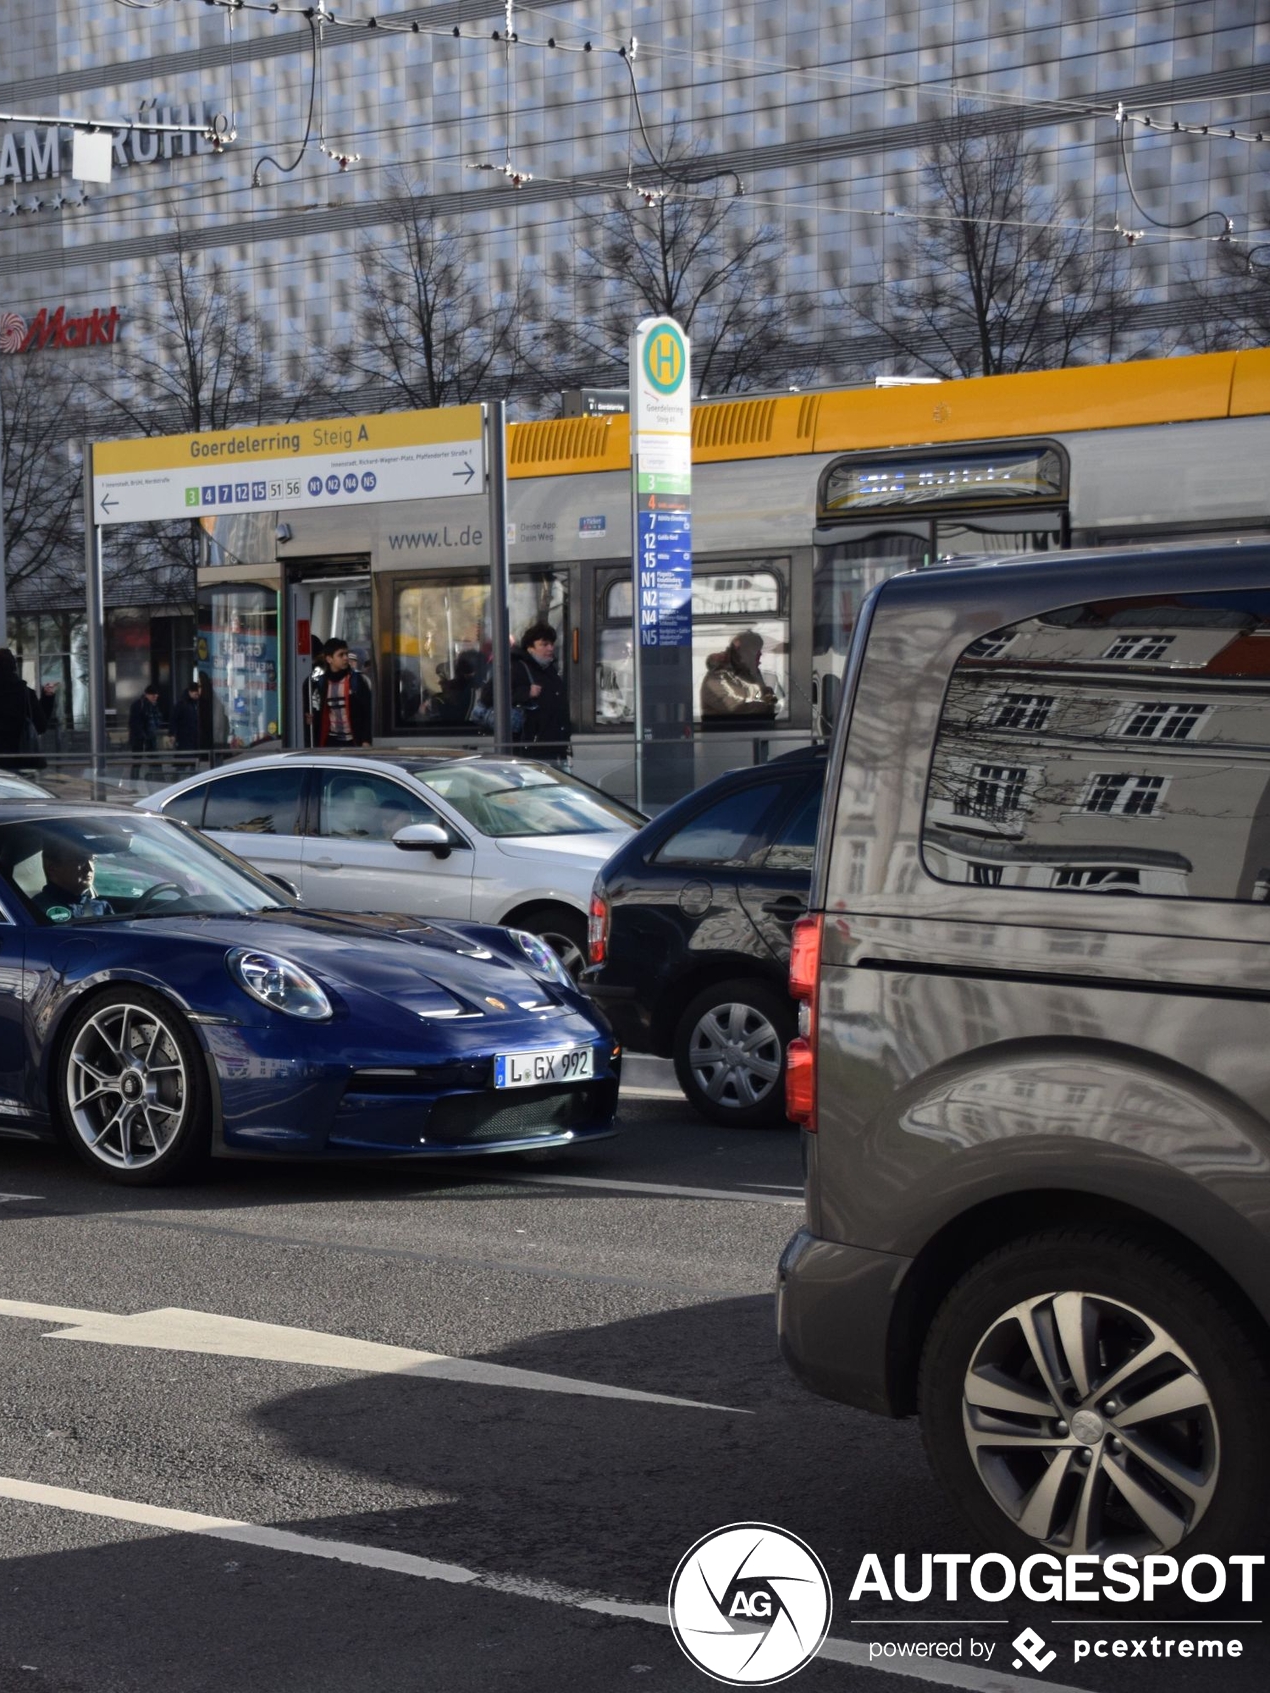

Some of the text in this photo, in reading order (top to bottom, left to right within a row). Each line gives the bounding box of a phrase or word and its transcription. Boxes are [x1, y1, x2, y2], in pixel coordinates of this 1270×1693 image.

[19, 305, 121, 353] Markt
[657, 340, 674, 378] H
[190, 424, 369, 458] Goerdelerring Steig A
[188, 476, 375, 504] 3 4 7 12 15 51 56 N1 N2 N4 N5
[648, 475, 655, 490] 3
[648, 494, 656, 510] 4
[520, 522, 541, 531] Deine
[649, 514, 657, 530] 7
[520, 533, 536, 542] Dein
[644, 533, 656, 549] 12
[644, 552, 657, 568] 15
[641, 572, 656, 588] N1
[643, 591, 658, 607] N2
[641, 609, 657, 626] N4
[642, 630, 658, 645] N5
[511, 1059, 522, 1083] L
[534, 1055, 555, 1080] GX
[562, 1050, 588, 1077] 992
